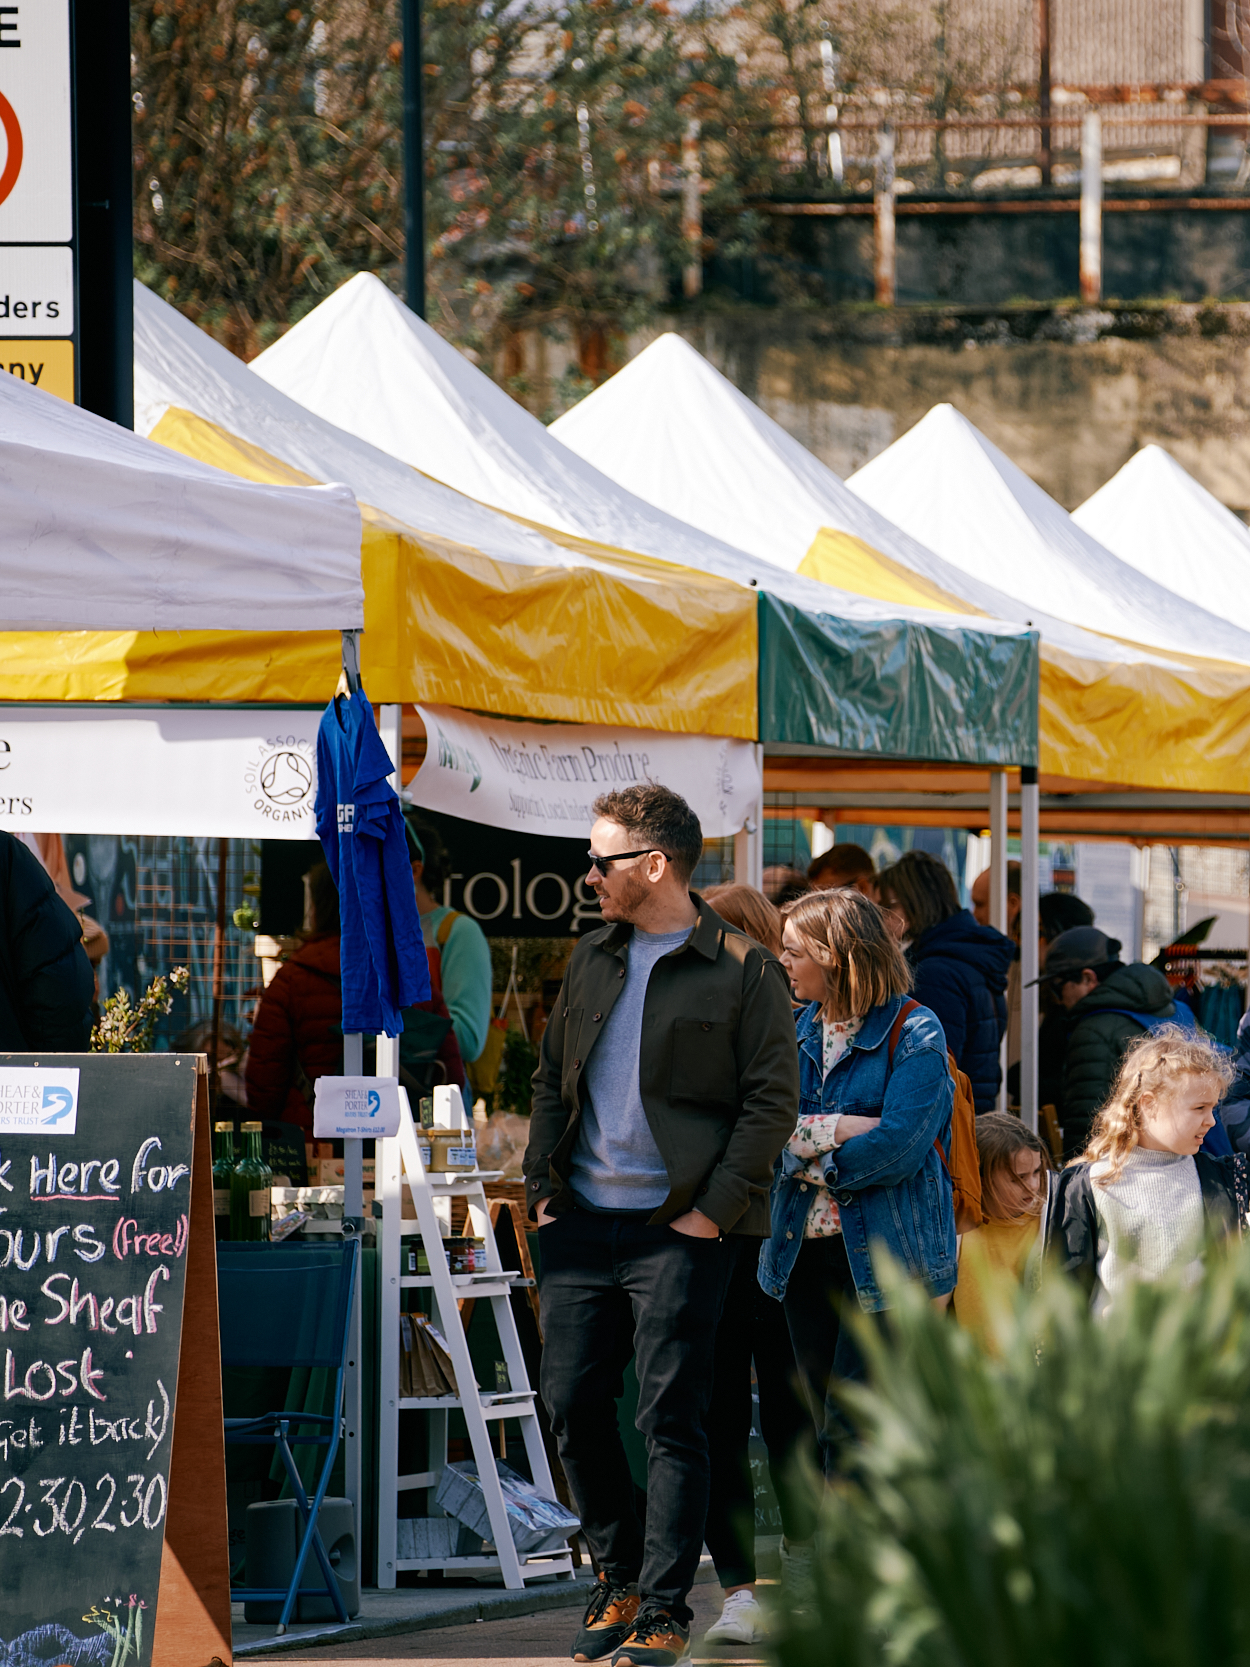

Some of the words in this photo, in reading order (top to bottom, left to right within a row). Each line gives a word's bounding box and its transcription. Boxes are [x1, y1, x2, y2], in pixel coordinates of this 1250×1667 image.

[0, 363, 44, 386] ny
[243, 760, 260, 794] SOIL
[253, 799, 315, 822] ORGANIC
[344, 1100, 368, 1111] PORTER
[13, 1117, 39, 1125] TRUST
[30, 1153, 121, 1194] Here
[131, 1137, 190, 1194] for
[41, 1264, 170, 1335] Sheaf
[4, 1347, 107, 1402] Lost
